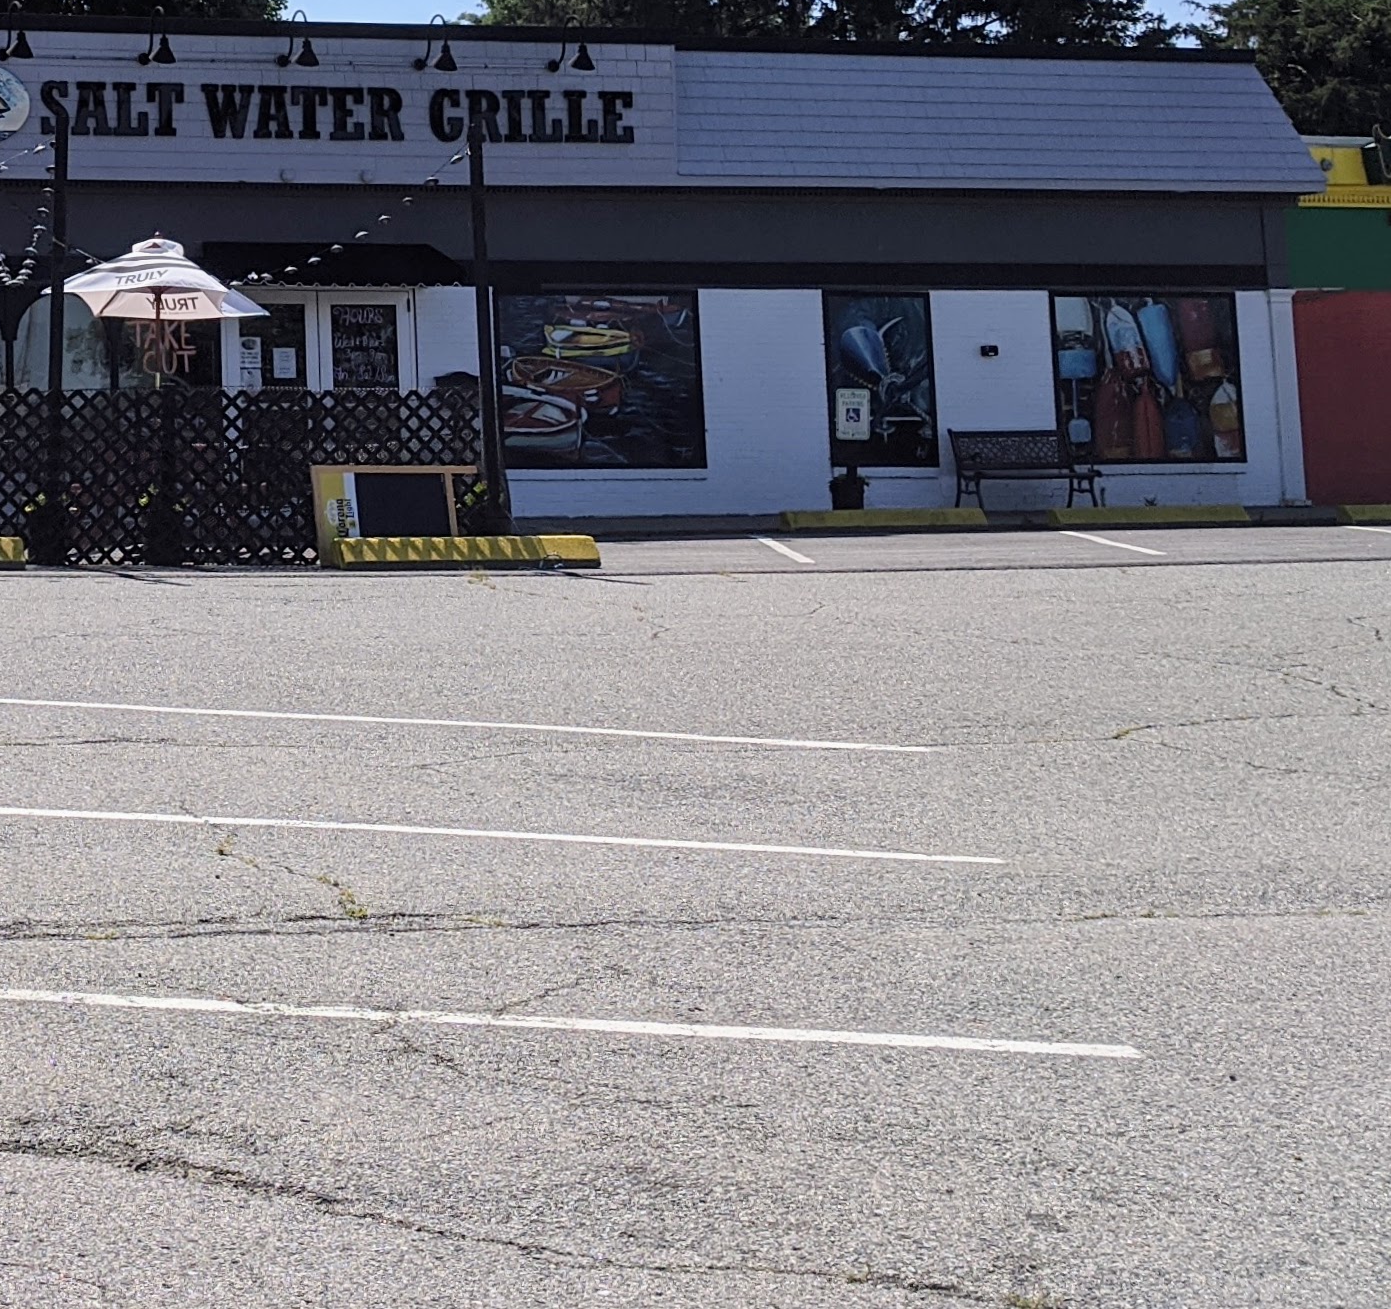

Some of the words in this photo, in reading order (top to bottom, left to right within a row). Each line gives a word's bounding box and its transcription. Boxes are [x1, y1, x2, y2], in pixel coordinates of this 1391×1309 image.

[40, 80, 184, 136] SALT
[200, 83, 404, 141] WATER
[429, 88, 635, 143] GRILLE
[115, 269, 168, 285] TRULY
[332, 306, 384, 326] HOURS
[125, 320, 196, 350] TAKE
[336, 498, 350, 538] Corona
